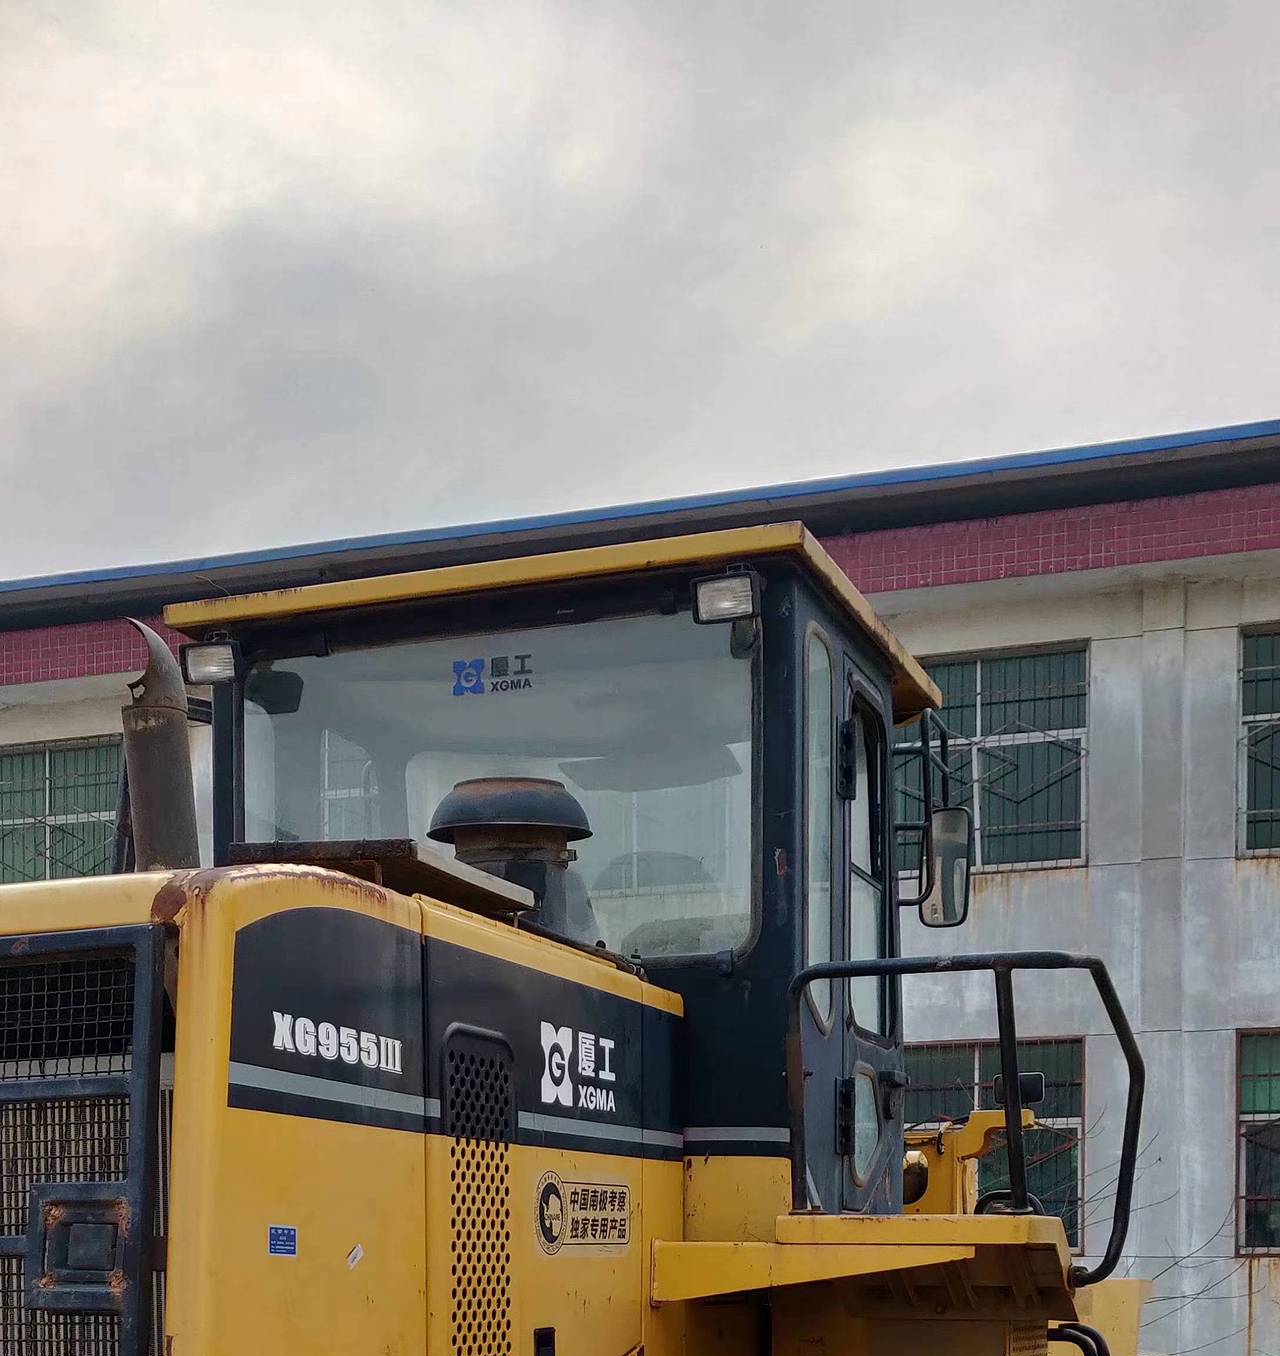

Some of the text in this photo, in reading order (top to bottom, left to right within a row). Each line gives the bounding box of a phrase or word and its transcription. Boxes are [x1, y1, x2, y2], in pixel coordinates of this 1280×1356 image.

[490, 678, 532, 693] XGMA
[578, 1031, 616, 1081] 厦工
[578, 1084, 616, 1113] XGMA
[569, 1187, 627, 1213] 中国南极考察
[569, 1216, 627, 1240] 独家专用产品
